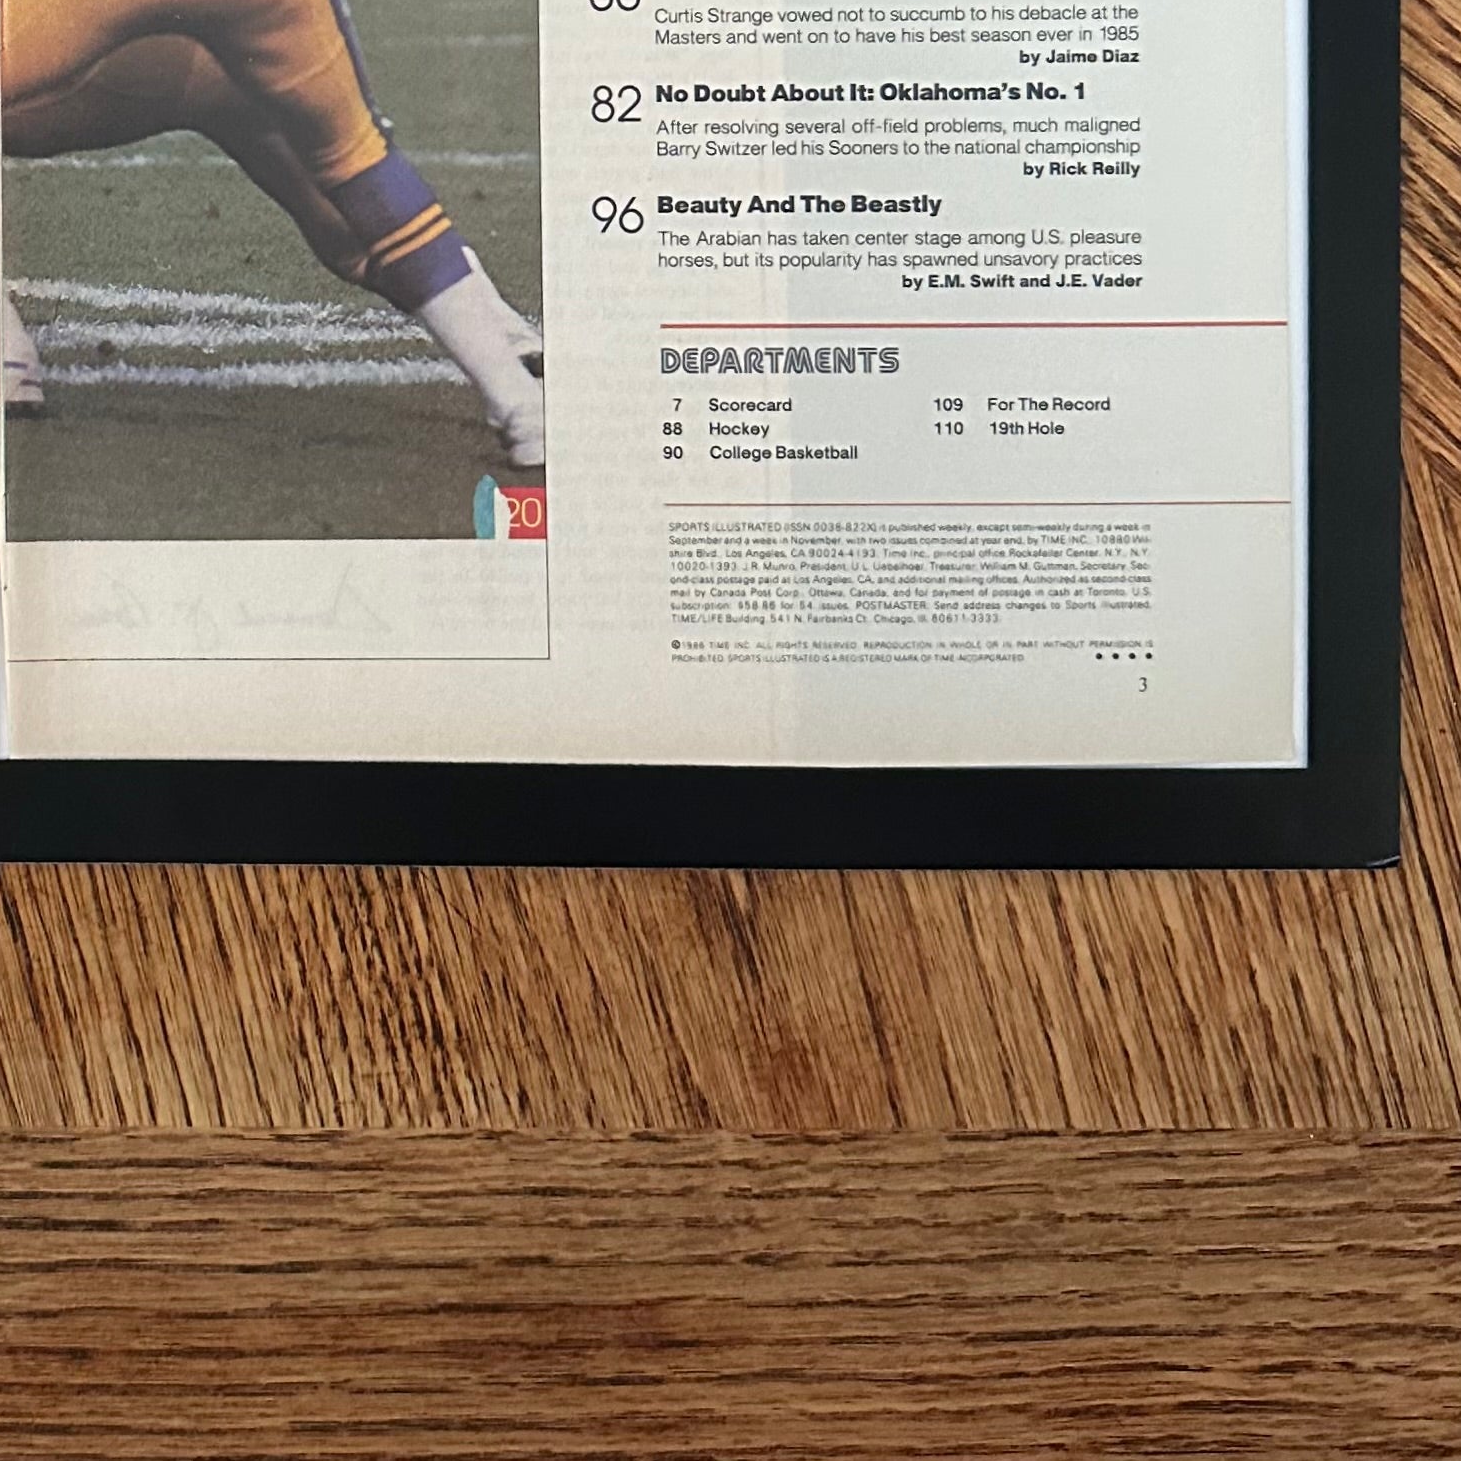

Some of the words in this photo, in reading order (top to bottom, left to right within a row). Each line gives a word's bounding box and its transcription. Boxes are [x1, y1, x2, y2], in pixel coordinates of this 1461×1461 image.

[655, 84, 688, 103] No
[693, 83, 766, 103] Doubt
[770, 83, 845, 102] About
[849, 82, 874, 102] It:
[879, 82, 1021, 101] Oklahoma’s
[1025, 81, 1067, 100] No.
[1073, 81, 1084, 100] 1
[591, 84, 642, 123] 82
[655, 119, 698, 135] After
[704, 118, 779, 138] resolving
[784, 117, 845, 134] several
[851, 117, 918, 134] off-field
[924, 117, 1007, 137] problems,
[1012, 116, 1058, 132] much
[1064, 116, 1140, 136] maligned
[656, 195, 742, 218] Beauty
[746, 194, 795, 213] And
[799, 194, 846, 213] The
[850, 194, 942, 217] Beastly
[591, 195, 644, 234] 96
[901, 274, 924, 291] by
[927, 273, 966, 288] E.M.
[969, 273, 1015, 288] Swift
[1019, 273, 1051, 288] and
[1055, 273, 1088, 288] J.E.
[1091, 272, 1143, 288] Vader
[660, 345, 899, 374] DEPARTMENTS
[672, 397, 682, 412] 7
[708, 397, 793, 412] Scorecard
[933, 397, 963, 412] 109
[987, 397, 1016, 411] For
[1017, 396, 1049, 411] The
[1051, 396, 1111, 411] Record
[662, 421, 683, 436] 88
[708, 421, 770, 439] Hockey
[933, 421, 964, 435] 110
[989, 420, 1024, 435] 19th
[1027, 420, 1065, 435] Hole
[662, 445, 683, 459] 90
[709, 444, 772, 463] College
[775, 444, 858, 460] Basketball
[668, 522, 709, 532] SPORTS
[1138, 676, 1147, 692] 3
